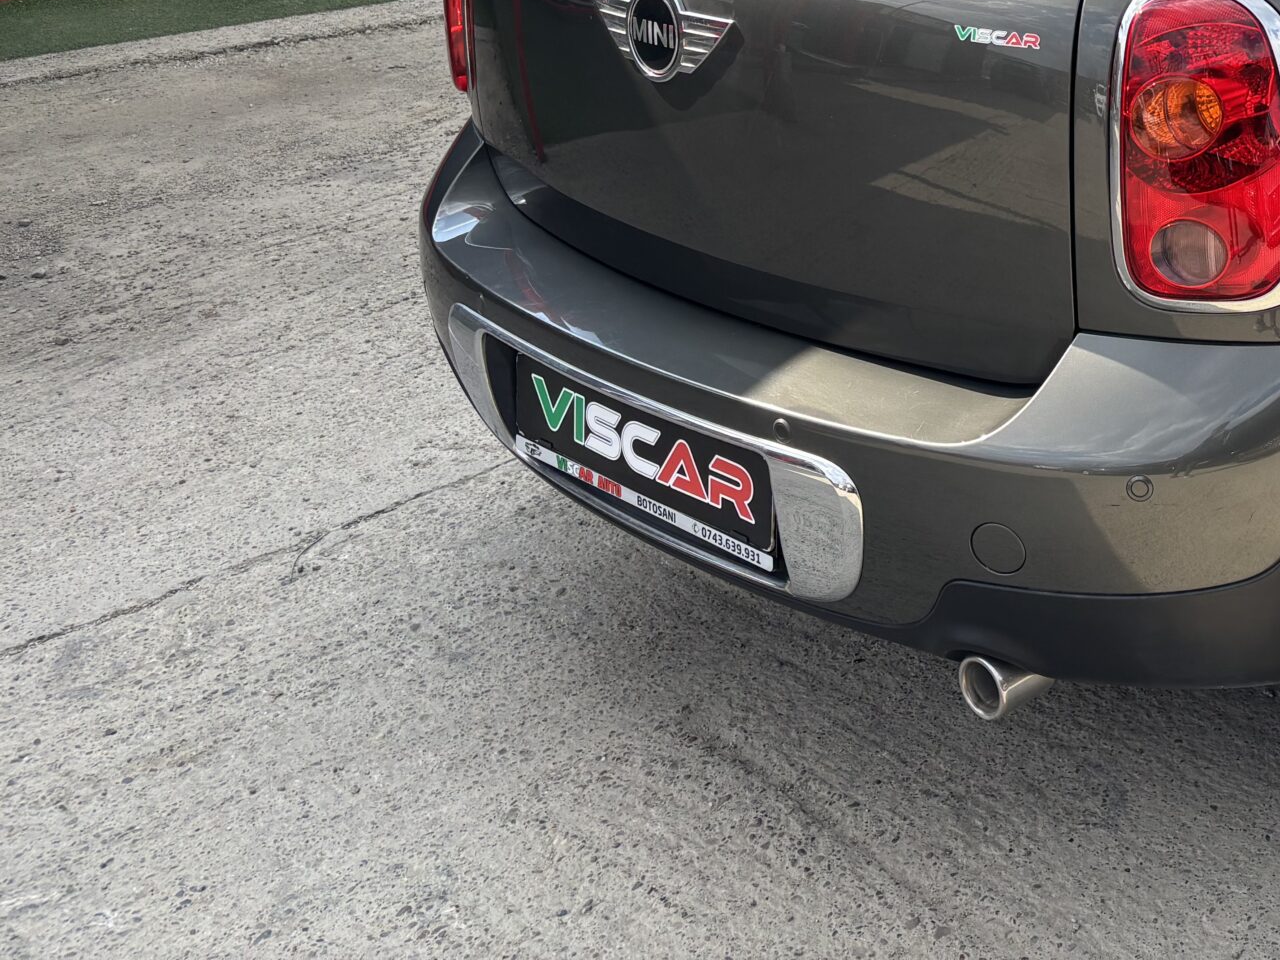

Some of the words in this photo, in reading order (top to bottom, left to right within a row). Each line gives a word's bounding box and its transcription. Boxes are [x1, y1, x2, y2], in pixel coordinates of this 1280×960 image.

[632, 16, 675, 50] MINI
[954, 25, 1040, 50] VISCAR
[531, 373, 755, 524] VISCAR
[556, 455, 594, 485] VISCAR
[597, 474, 622, 499] AUTO
[636, 495, 677, 525] BOTOSANI
[700, 526, 762, 565] 0743.639.931
